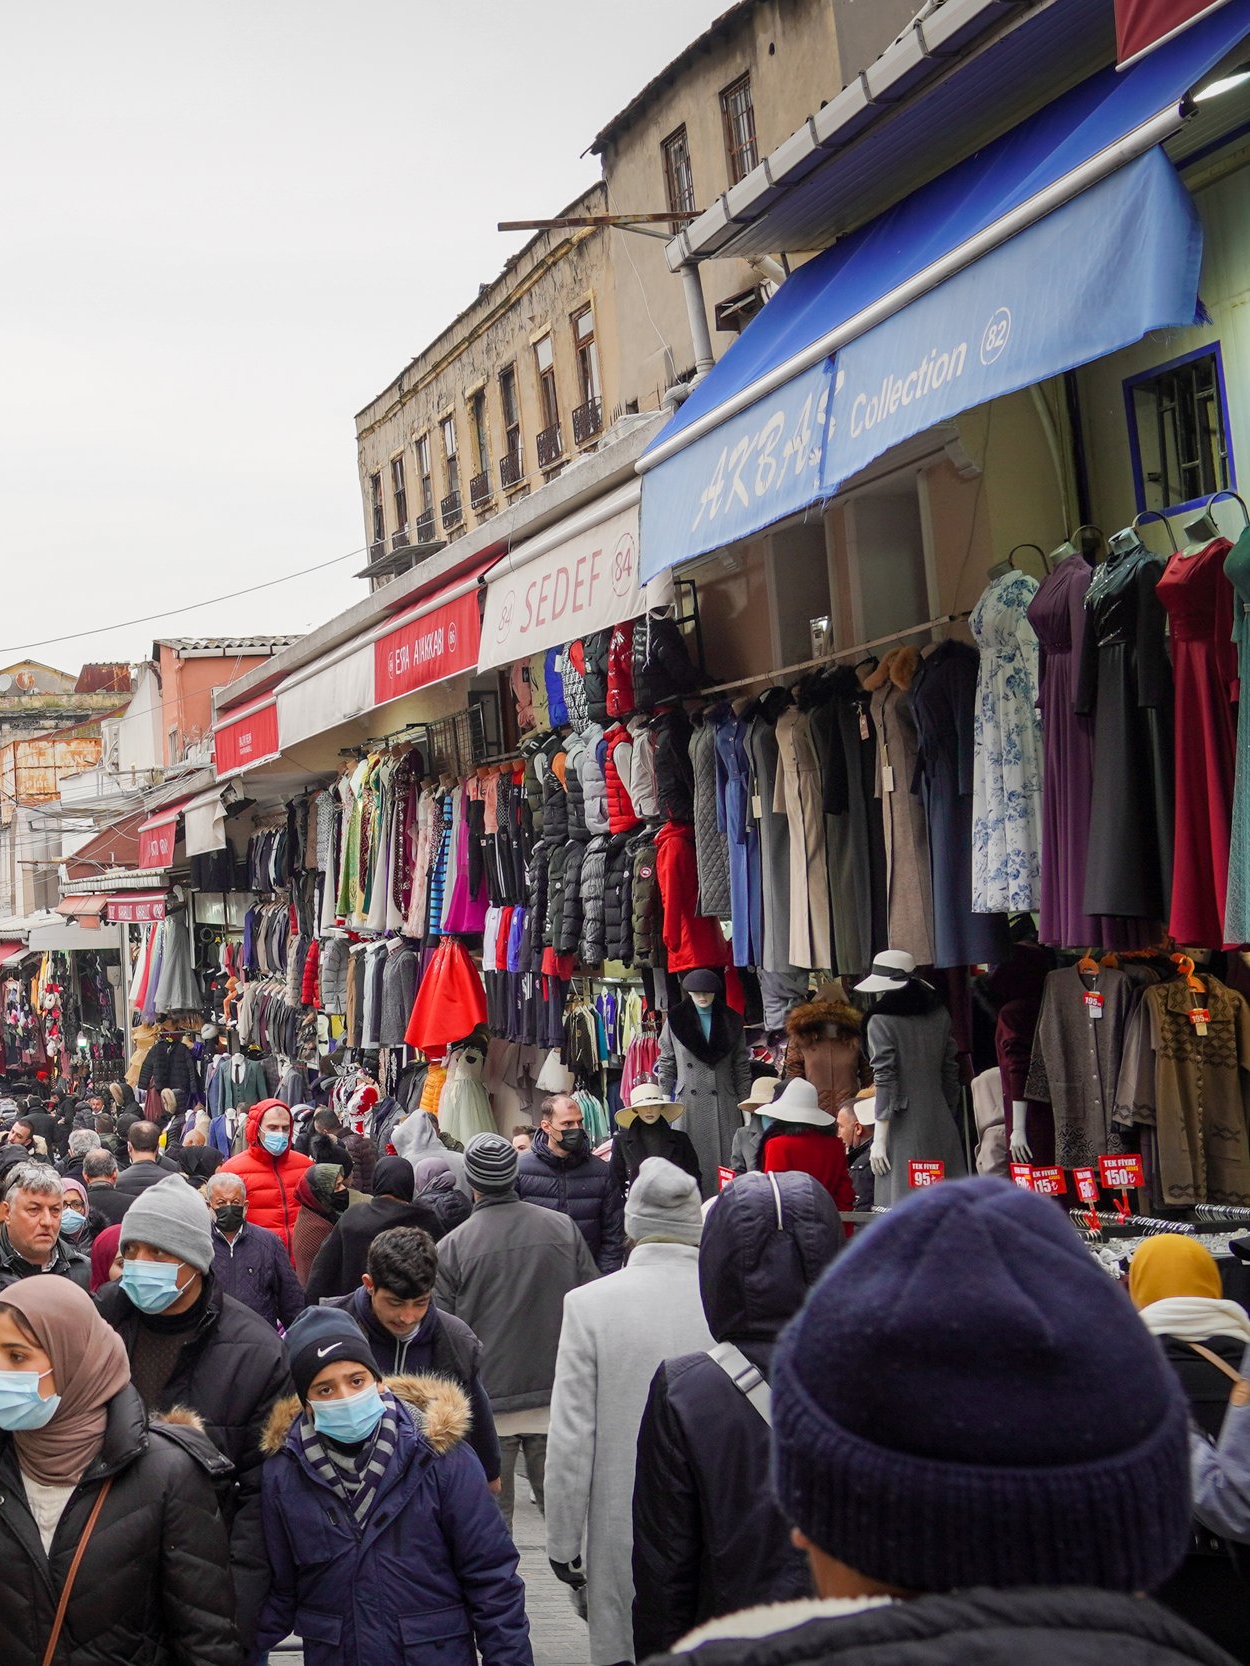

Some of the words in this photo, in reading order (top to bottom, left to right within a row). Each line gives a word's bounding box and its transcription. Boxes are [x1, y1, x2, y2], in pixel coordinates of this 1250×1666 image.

[851, 342, 968, 439] Collection
[986, 319, 1007, 351] 82
[519, 549, 603, 634] SEDEF
[614, 547, 633, 582] 84
[395, 644, 410, 675] ESRA
[413, 626, 445, 667] AYAKKABI
[1103, 1160, 1118, 1168] TEK
